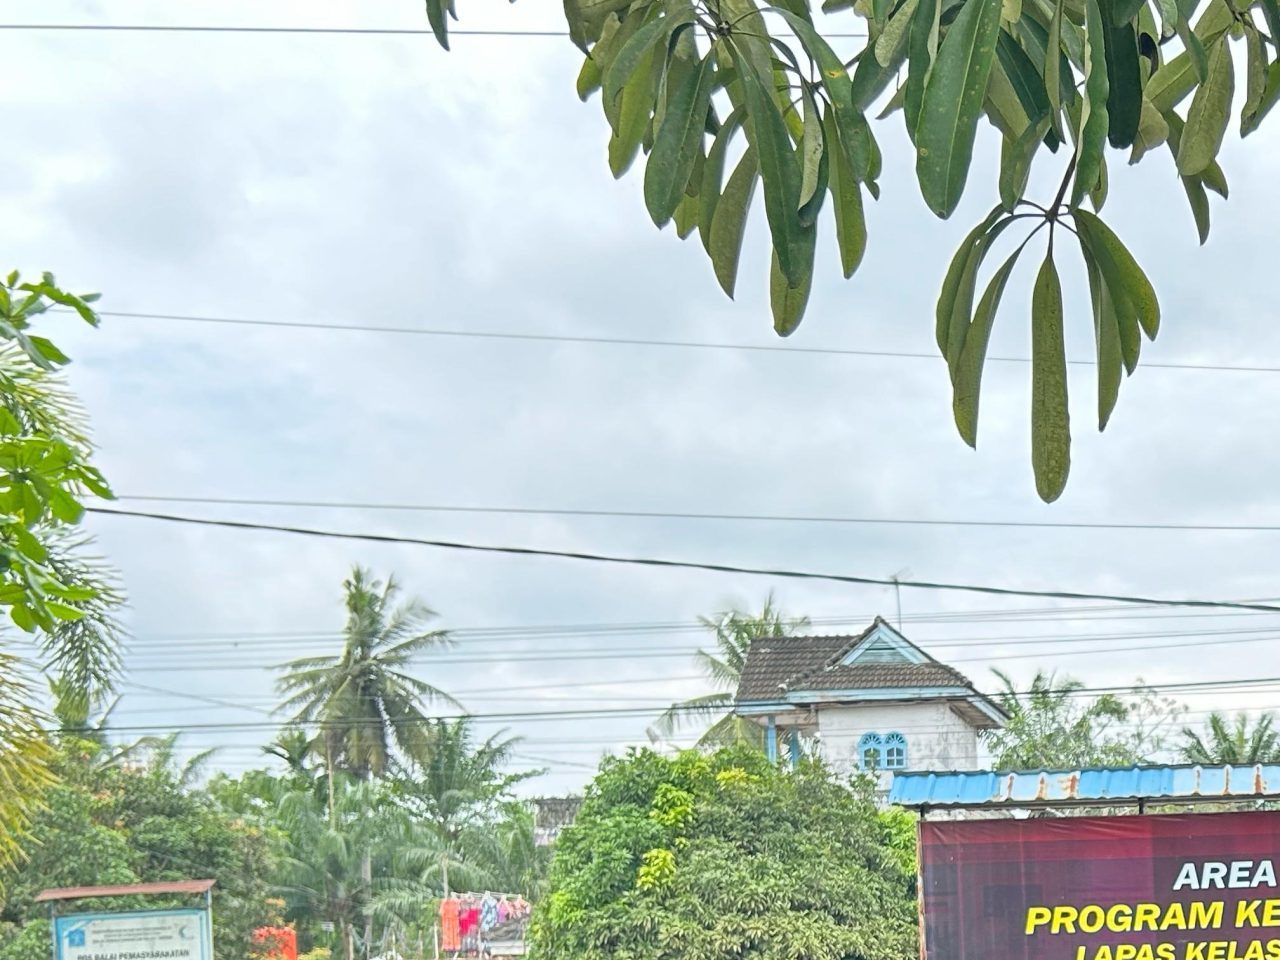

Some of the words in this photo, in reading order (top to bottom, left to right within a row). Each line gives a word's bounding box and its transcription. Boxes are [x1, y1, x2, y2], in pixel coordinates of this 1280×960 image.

[1172, 859, 1277, 890] AREA
[1024, 901, 1225, 935] PROGRAM
[94, 952, 117, 960] BALAI
